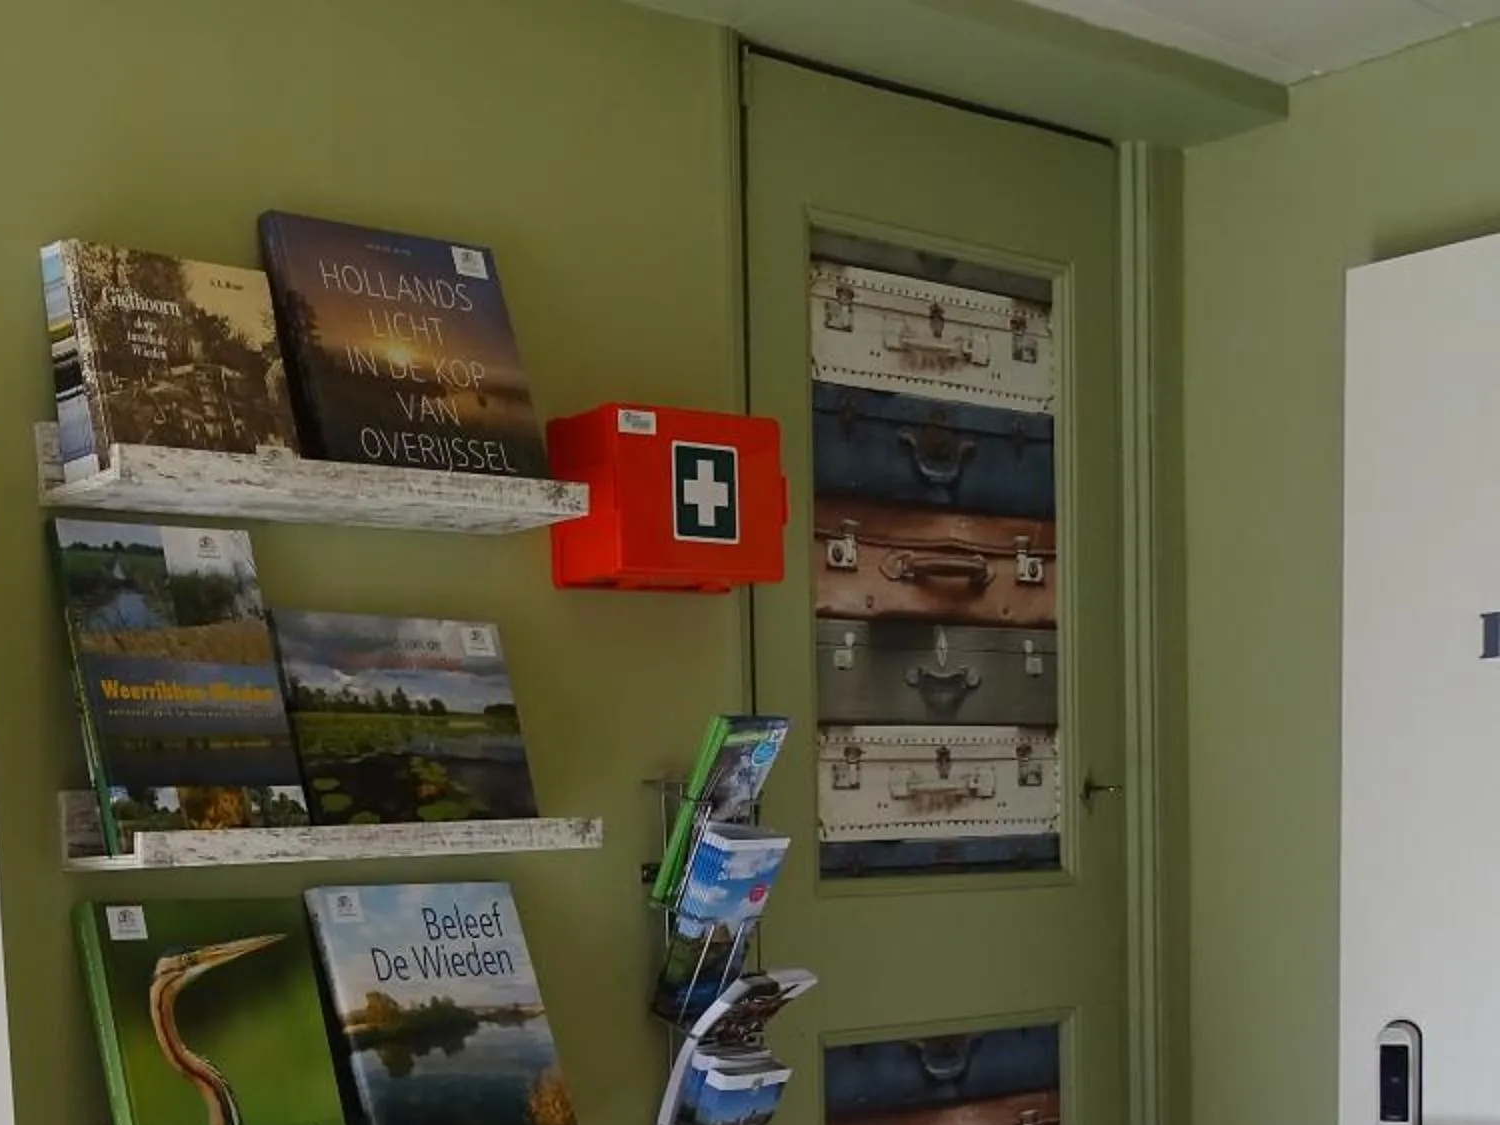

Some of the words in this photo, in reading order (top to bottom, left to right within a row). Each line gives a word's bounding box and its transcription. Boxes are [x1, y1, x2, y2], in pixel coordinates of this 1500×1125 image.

[102, 285, 181, 317] Giethoorn
[318, 260, 473, 312] HOLLANDS
[368, 310, 445, 346] LICHT
[346, 344, 378, 377] IN
[389, 351, 426, 383] DE
[434, 355, 485, 389] KOP
[396, 391, 461, 426] VAN
[360, 427, 516, 473] OVERIJSSEL
[422, 902, 504, 941] Beleef
[371, 946, 411, 981] De
[411, 943, 515, 979] Wieden
